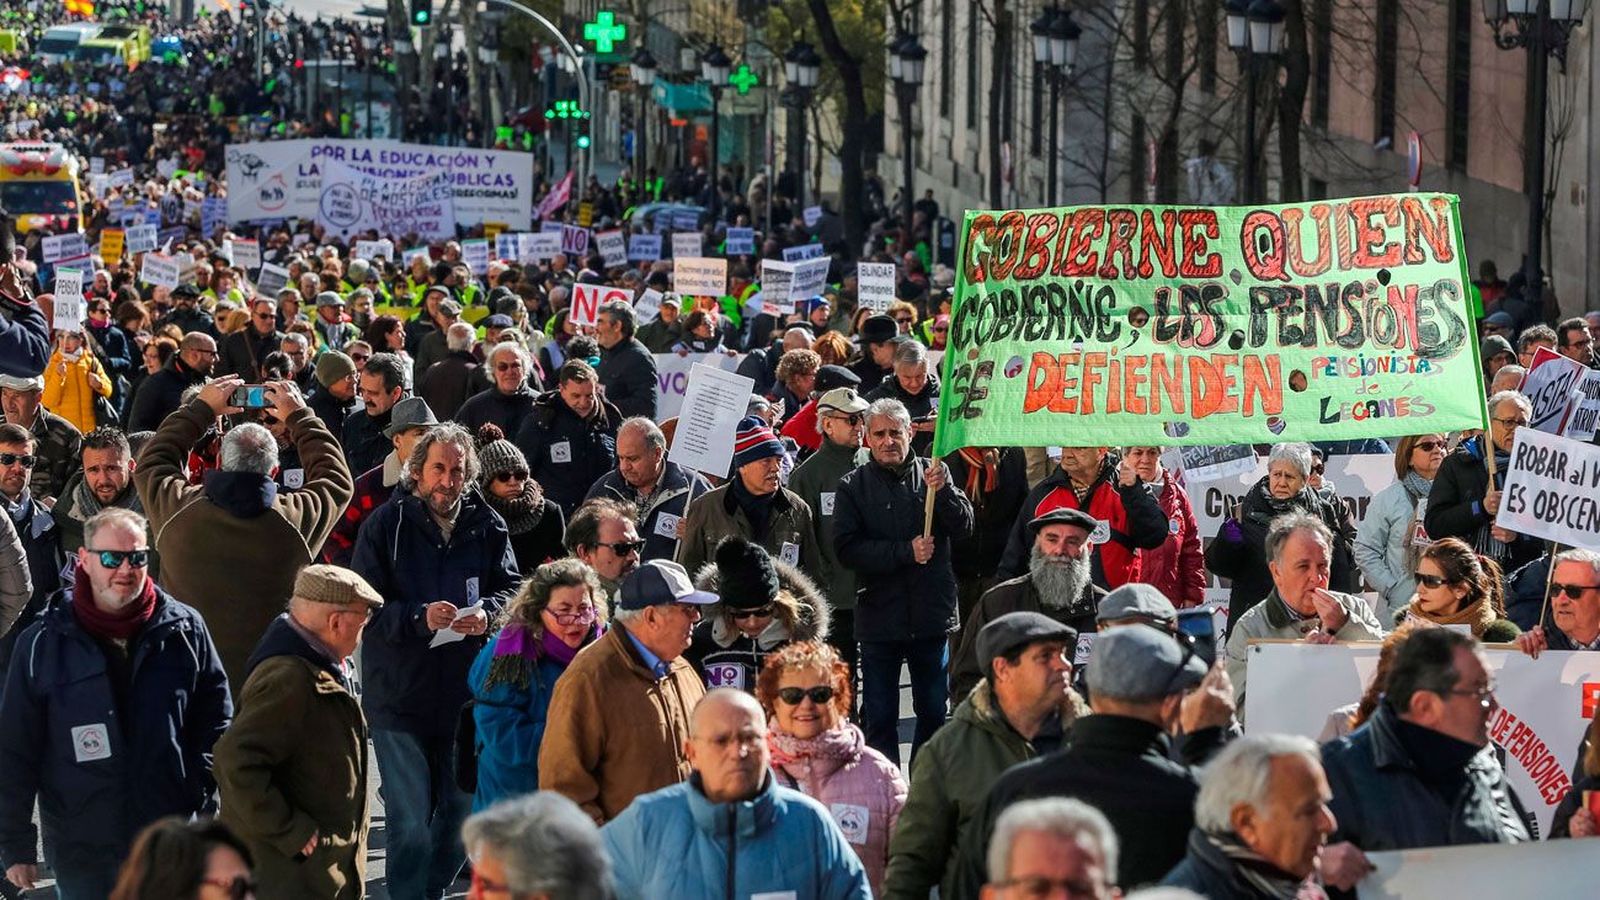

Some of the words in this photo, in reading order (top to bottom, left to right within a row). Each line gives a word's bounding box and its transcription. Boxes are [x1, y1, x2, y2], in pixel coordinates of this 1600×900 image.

[311, 145, 345, 161] POR
[352, 147, 373, 162] LA
[380, 150, 478, 168] EDUCACIÓN
[485, 155, 496, 168] Y
[561, 228, 587, 252] NO
[964, 207, 1224, 285] GOBIERNE
[1240, 196, 1454, 282] QUIEN
[861, 264, 894, 278] BLINDAR
[1152, 282, 1230, 351] LAS
[1249, 279, 1467, 360] PENSIONES
[1311, 351, 1444, 379] PENSIONISTAS
[949, 360, 995, 423] SE
[1355, 378, 1383, 396] de
[1515, 441, 1568, 482] ROBAR
[1569, 459, 1586, 487] al
[1507, 483, 1527, 514] ES
[1491, 708, 1517, 743] DE
[1504, 720, 1574, 807] PENSIONES
